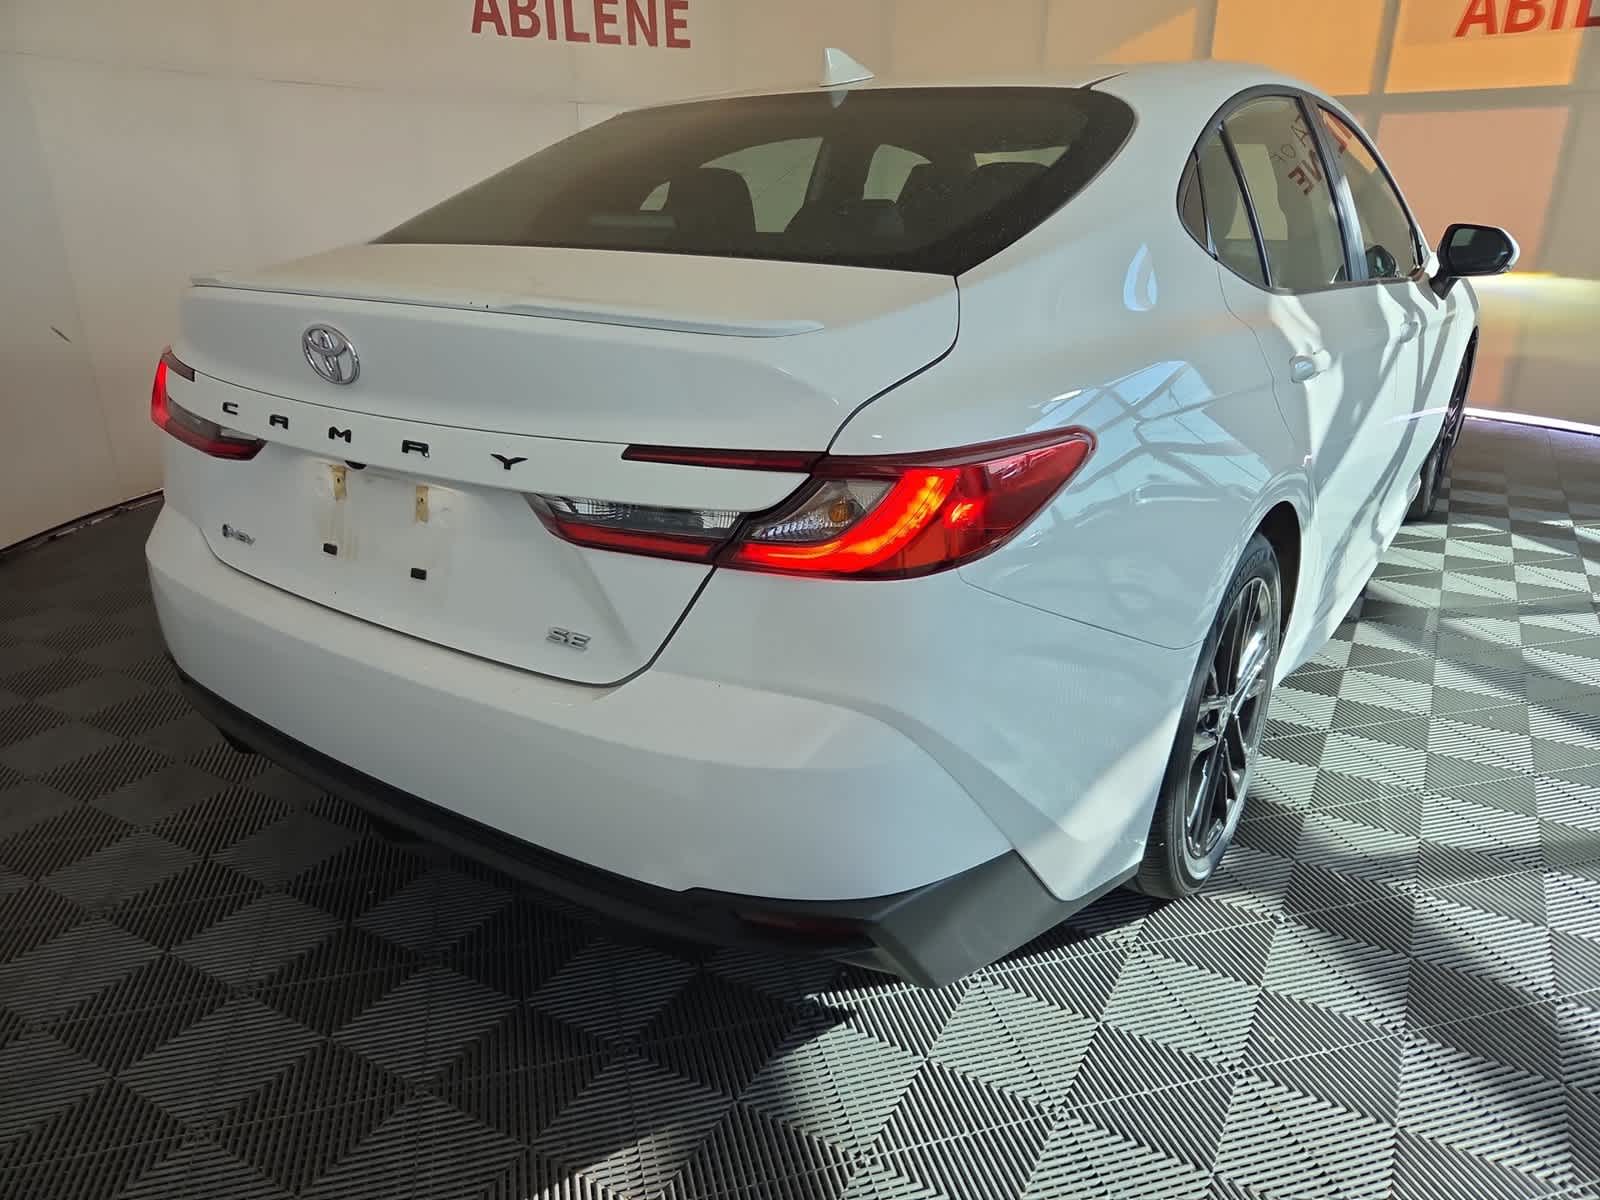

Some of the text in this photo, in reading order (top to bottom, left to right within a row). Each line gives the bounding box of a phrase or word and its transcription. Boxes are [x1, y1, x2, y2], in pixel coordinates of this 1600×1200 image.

[471, 0, 691, 48] ABILENE
[222, 401, 528, 470] CAMRY
[546, 626, 591, 651] SE
